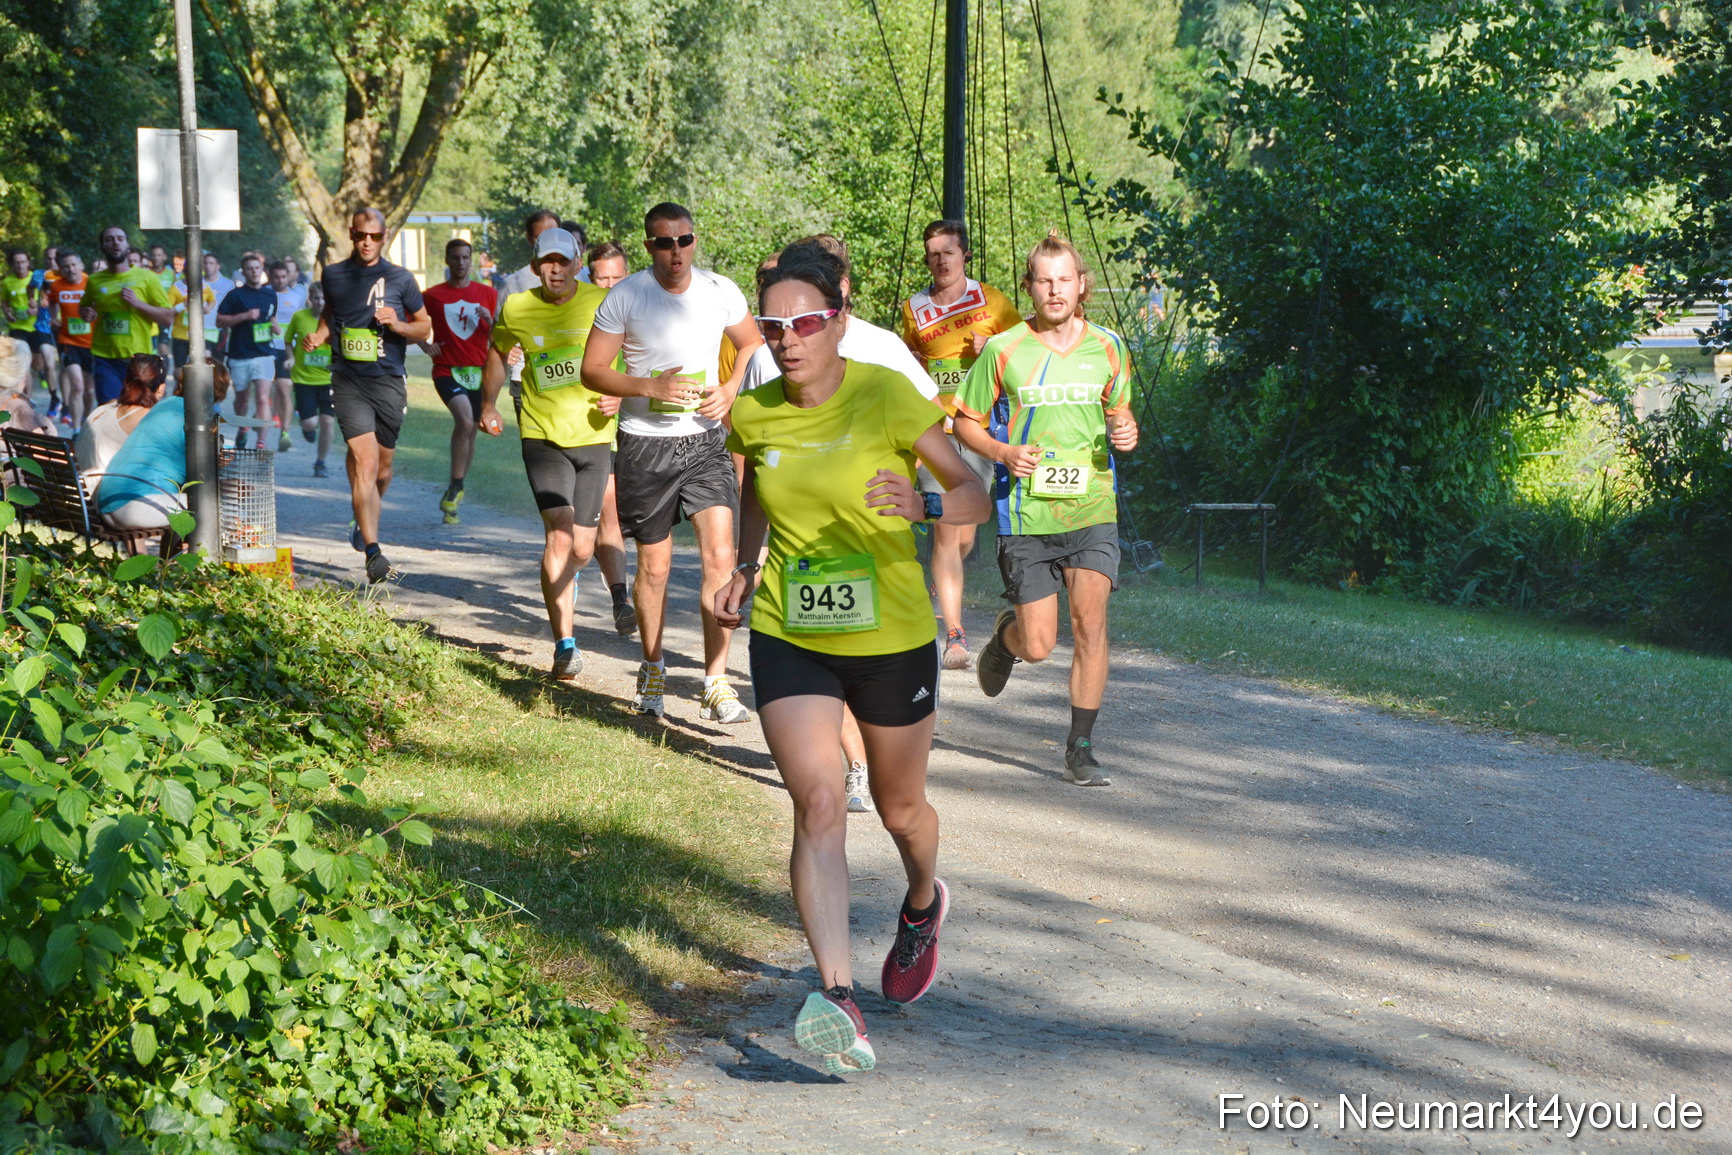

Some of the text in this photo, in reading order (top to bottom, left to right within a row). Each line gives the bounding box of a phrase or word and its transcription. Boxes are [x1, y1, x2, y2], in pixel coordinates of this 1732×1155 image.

[921, 311, 992, 344] MAX BÖGL
[343, 339, 371, 352] 1603
[458, 374, 475, 383] 393
[544, 361, 575, 379] 906
[1018, 383, 1104, 407] BOCK
[1045, 467, 1080, 485] 232
[800, 584, 855, 612] 943
[833, 611, 861, 620] Kerstin
